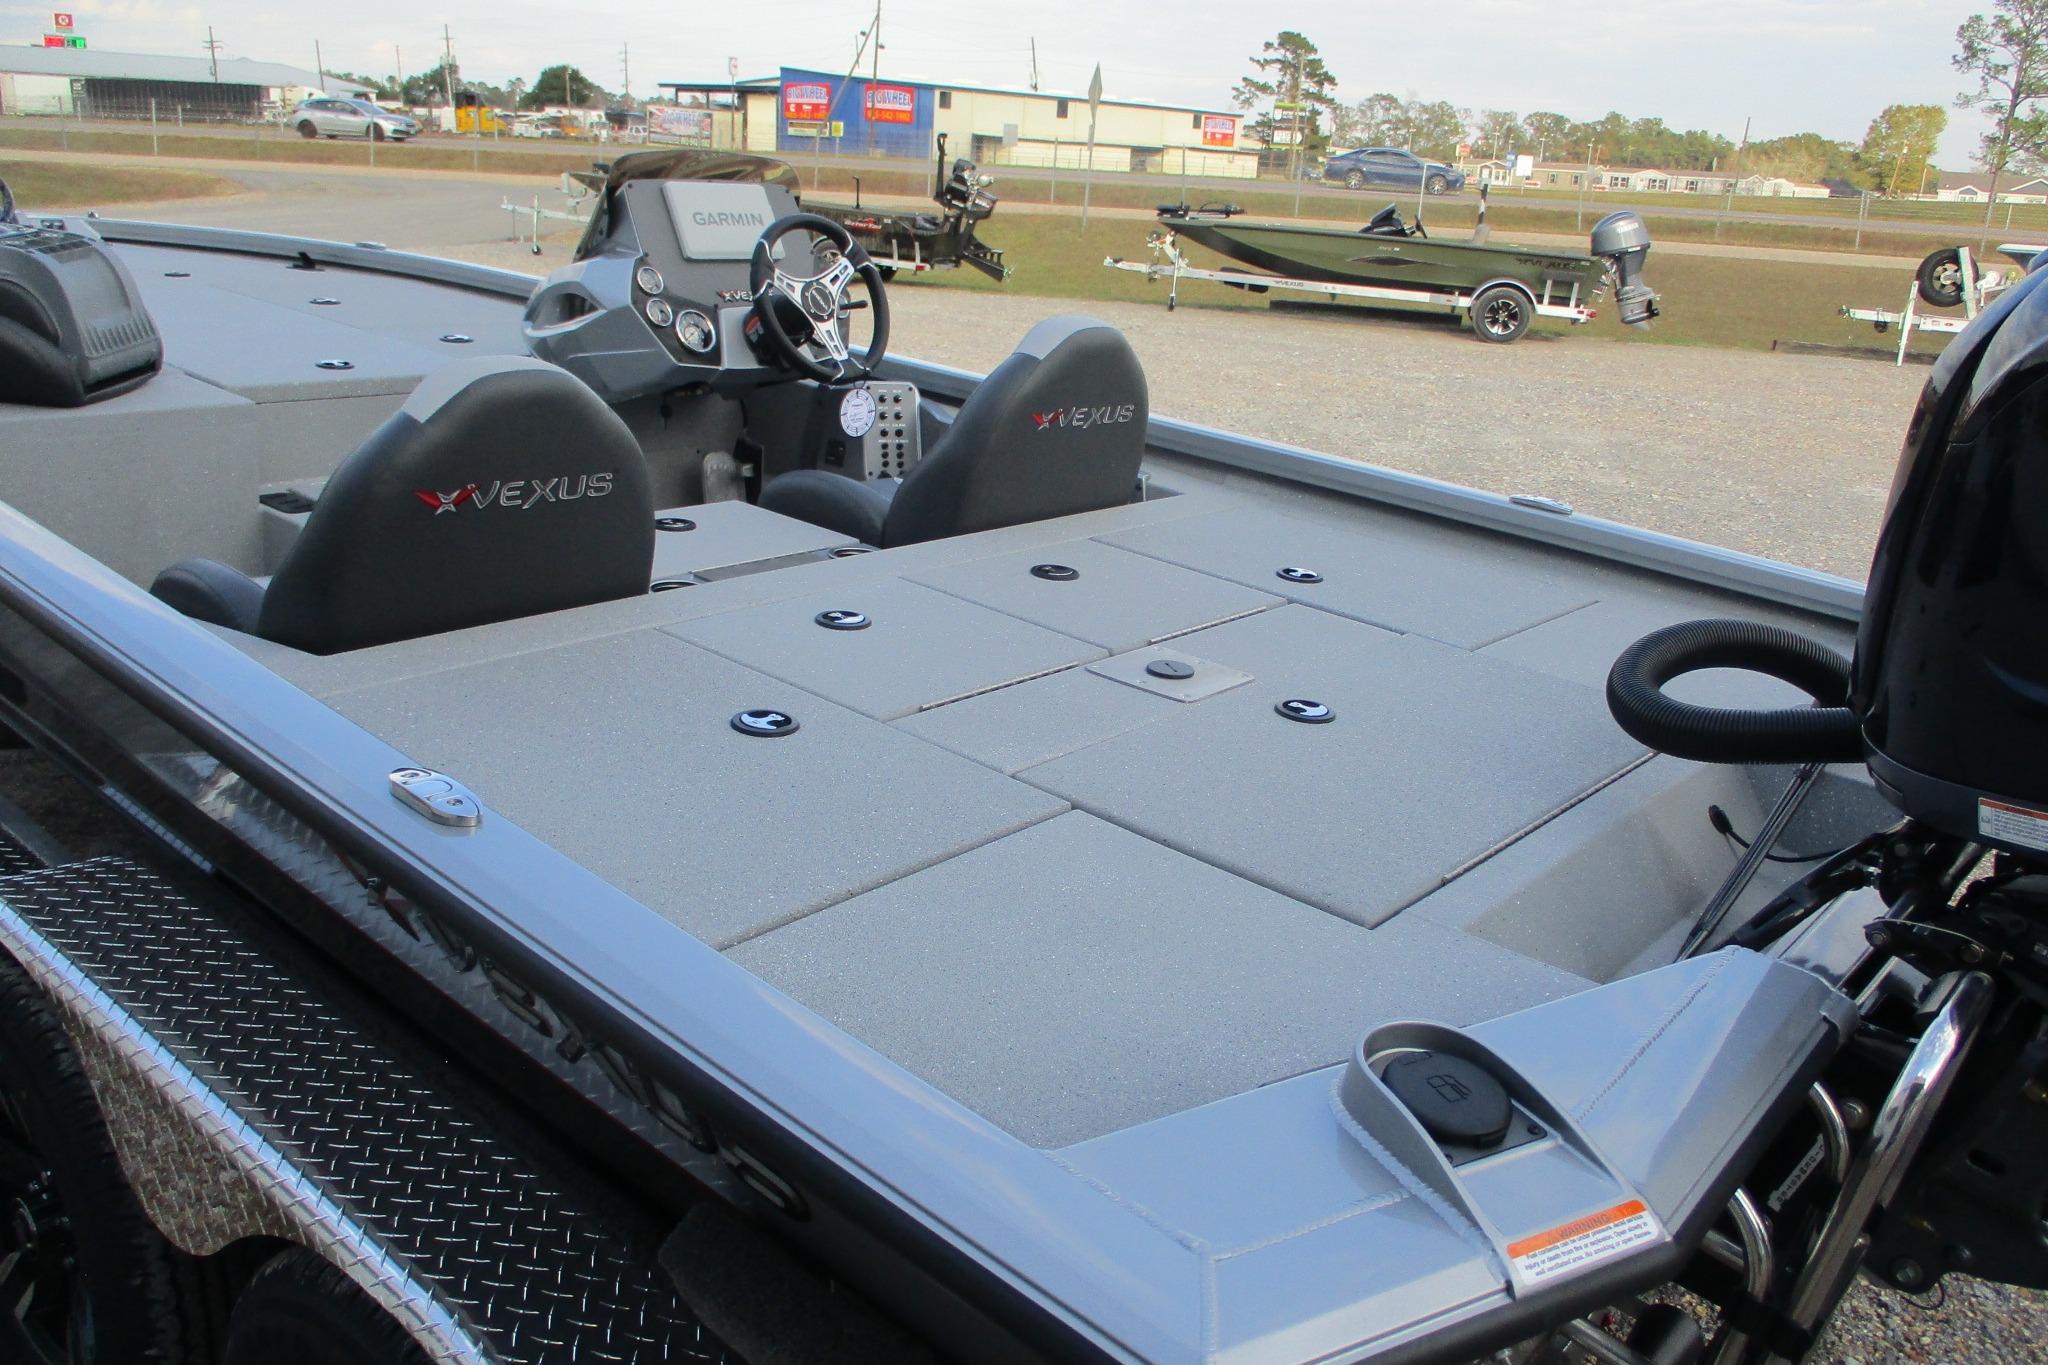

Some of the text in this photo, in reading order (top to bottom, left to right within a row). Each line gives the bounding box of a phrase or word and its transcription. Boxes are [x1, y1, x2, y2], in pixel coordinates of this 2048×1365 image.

[883, 90, 911, 107] WHEEL
[692, 212, 764, 227] GARMIN
[1059, 404, 1135, 429] VEXUS
[468, 472, 613, 510] VEXUS
[1560, 1213, 1610, 1239] WARNING
[1576, 1232, 1590, 1241] under
[1546, 1252, 1562, 1262] death
